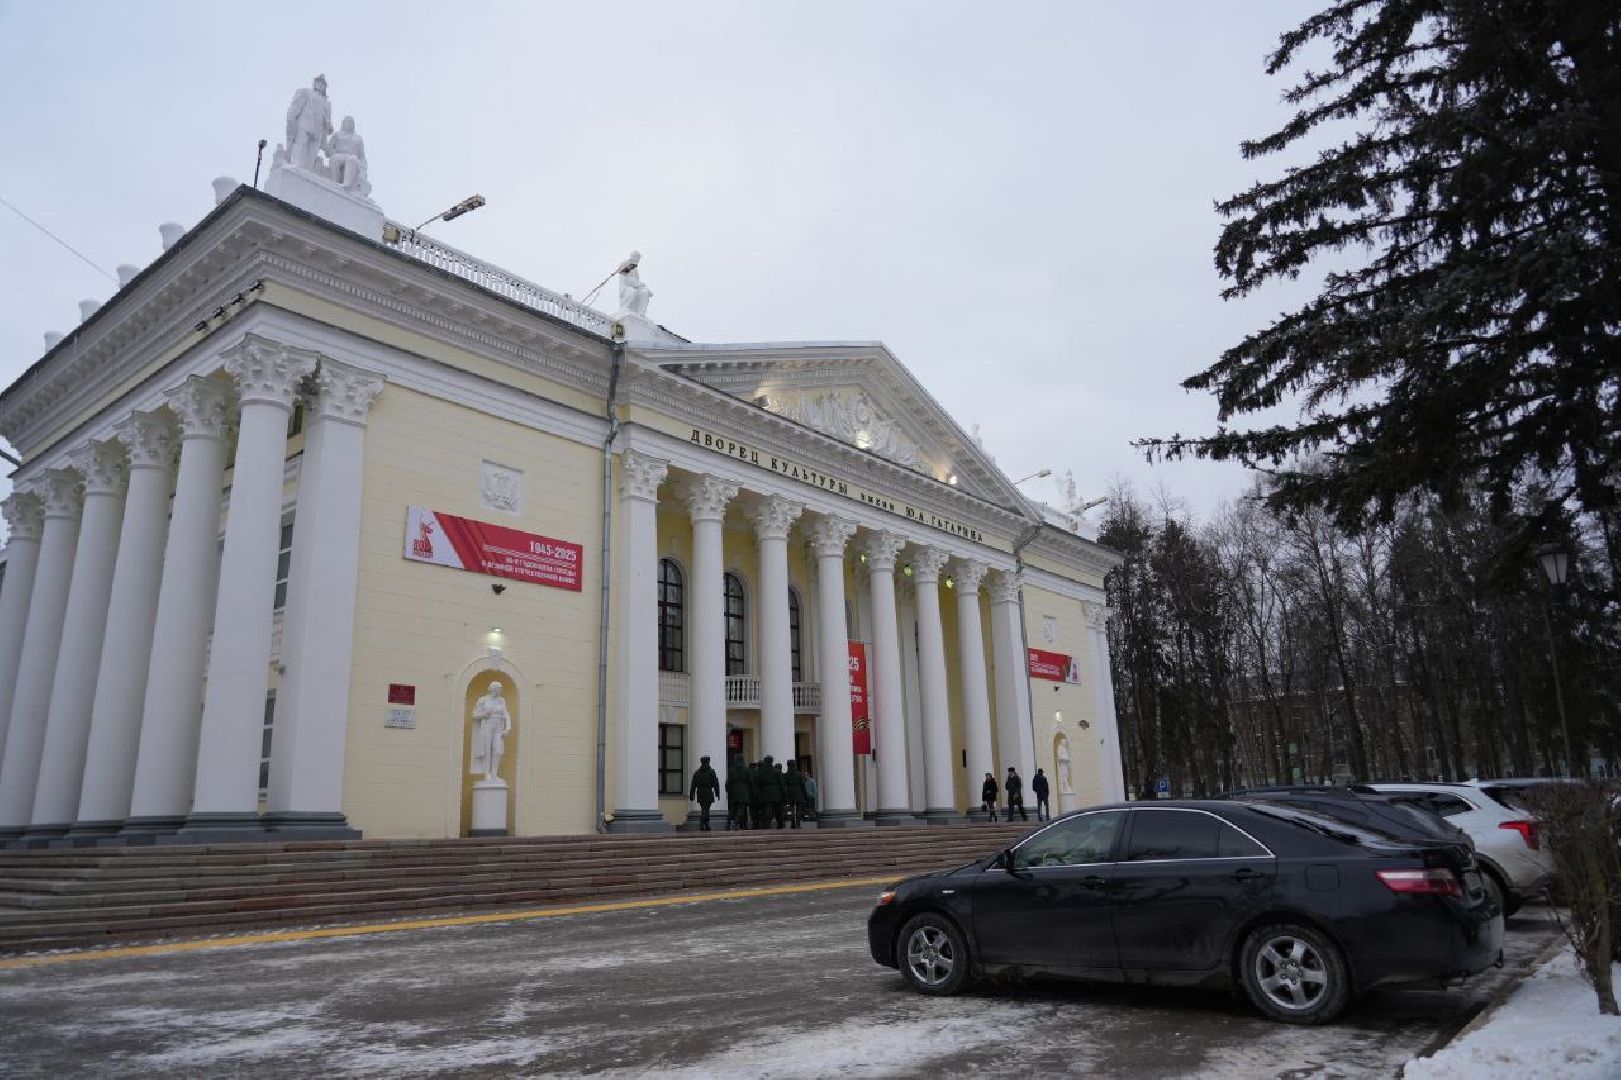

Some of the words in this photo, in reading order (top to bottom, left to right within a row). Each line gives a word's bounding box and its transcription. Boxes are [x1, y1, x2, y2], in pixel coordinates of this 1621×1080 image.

[691, 429, 759, 465] ДВОРЕЦ
[771, 457, 848, 495] КУЛЬТУРЫ
[529, 540, 577, 560] 1945-2025
